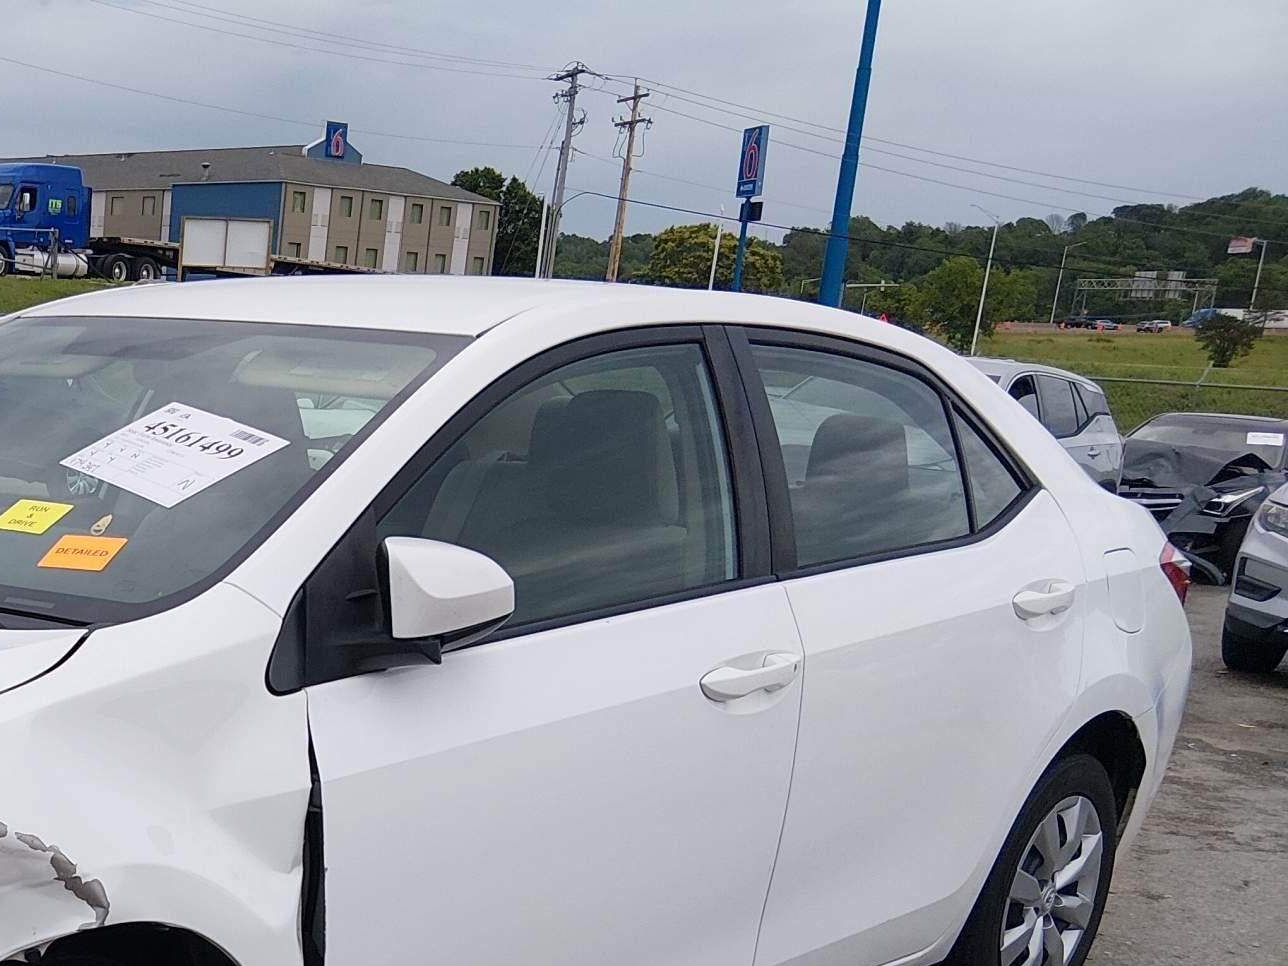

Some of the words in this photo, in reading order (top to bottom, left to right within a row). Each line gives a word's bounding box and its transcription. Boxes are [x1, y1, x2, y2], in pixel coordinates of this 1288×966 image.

[144, 421, 244, 460] 45161499
[28, 505, 51, 513] RUN
[7, 518, 38, 528] DRIVE
[55, 547, 110, 557] DETAILED
